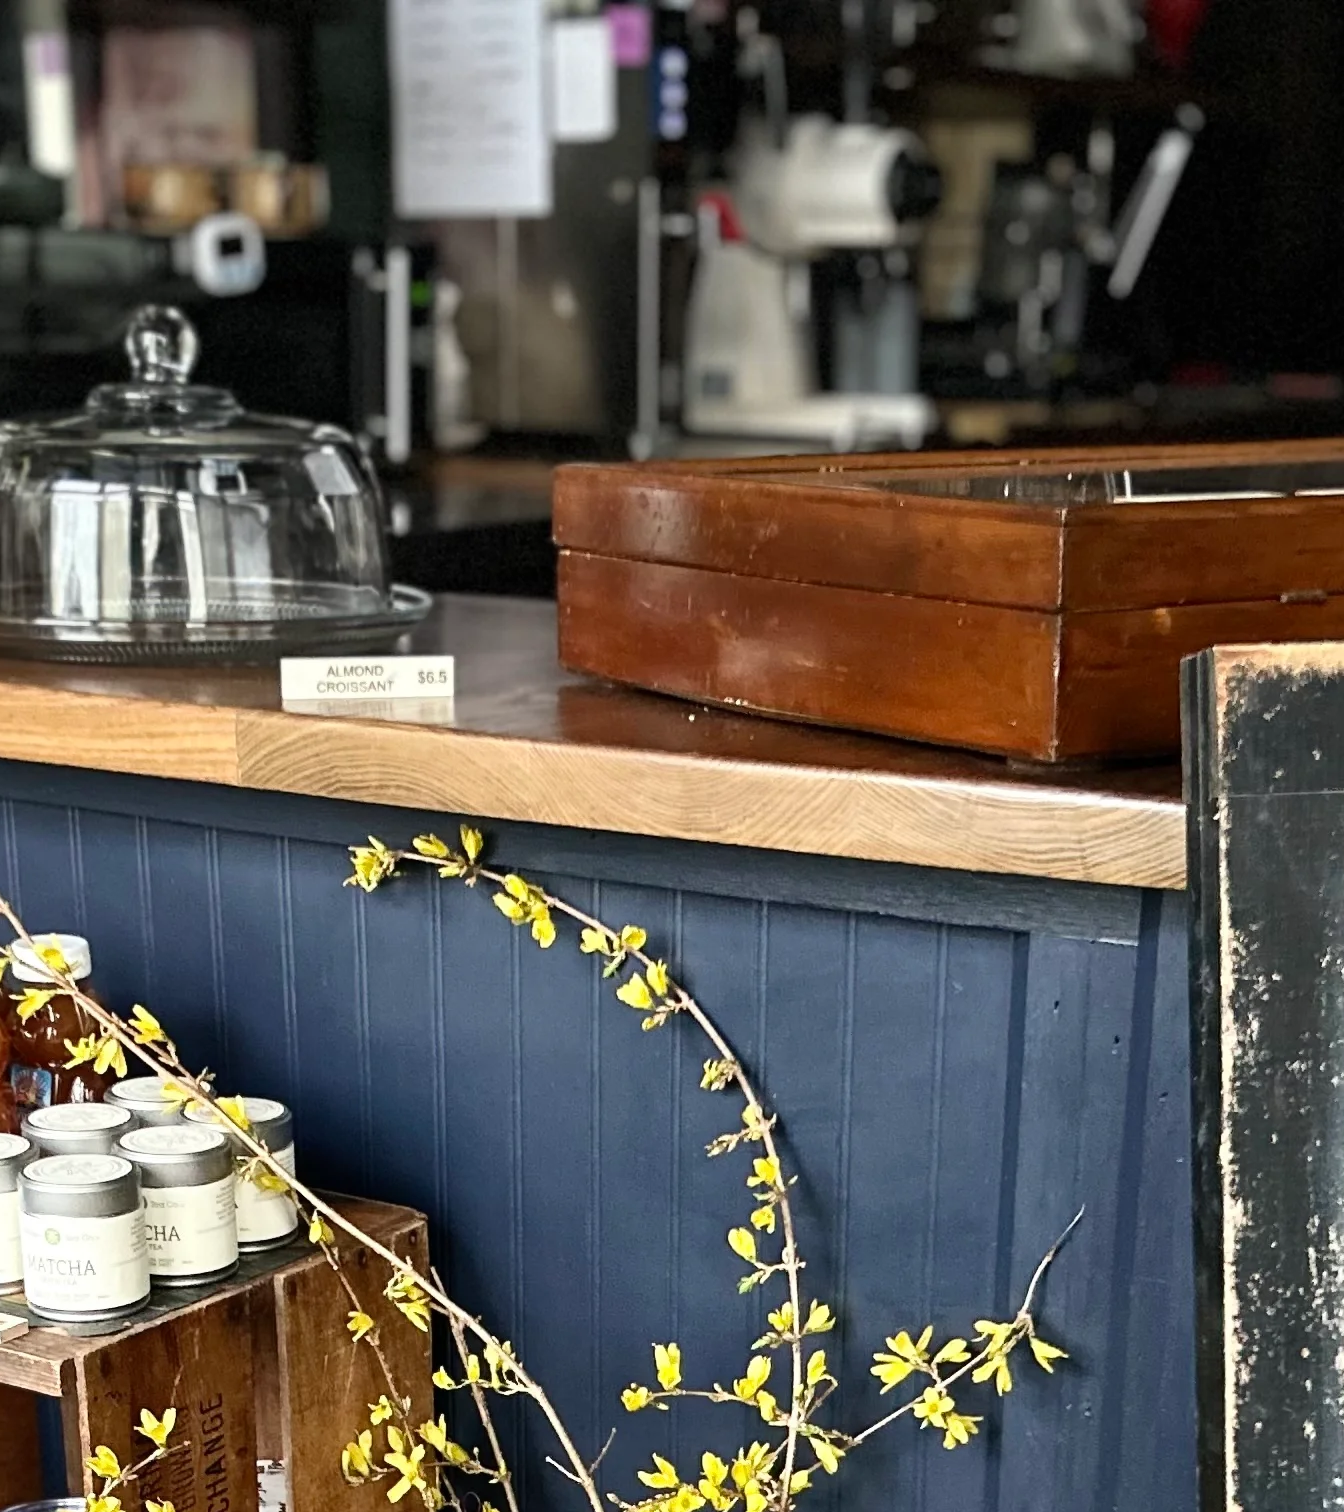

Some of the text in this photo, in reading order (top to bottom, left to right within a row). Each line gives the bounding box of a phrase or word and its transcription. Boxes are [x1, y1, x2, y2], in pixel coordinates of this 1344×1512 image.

[326, 665, 384, 678] ALMOND
[417, 670, 448, 684] $6.5
[316, 680, 394, 694] CROISSANT
[145, 1224, 181, 1241] CHA
[27, 1253, 97, 1277] MATCHA
